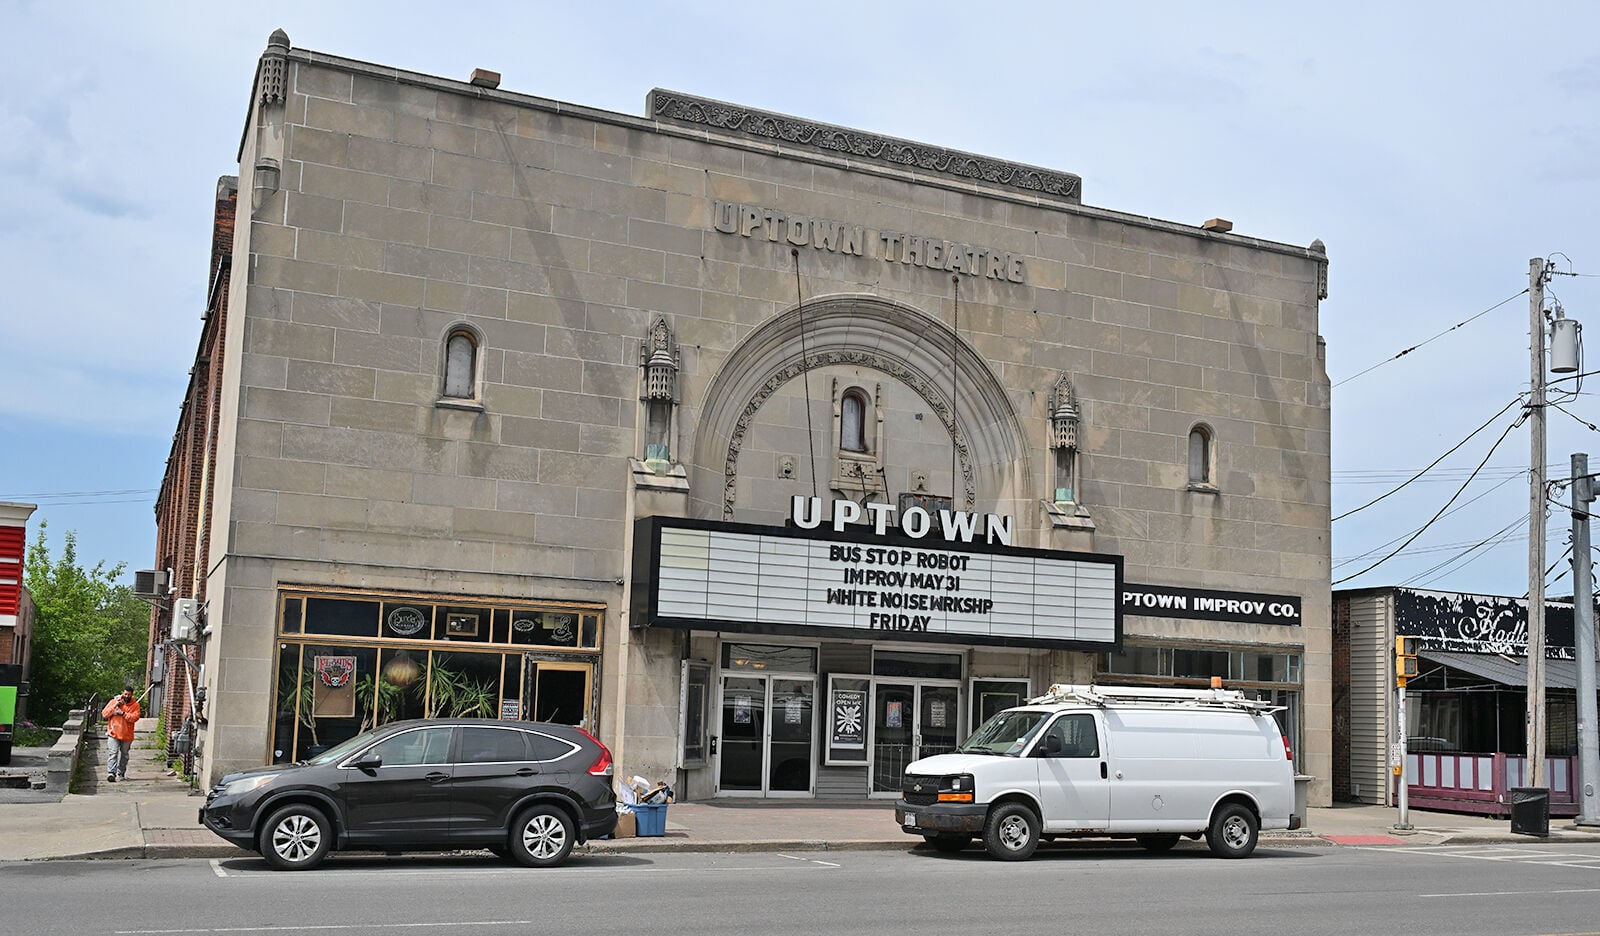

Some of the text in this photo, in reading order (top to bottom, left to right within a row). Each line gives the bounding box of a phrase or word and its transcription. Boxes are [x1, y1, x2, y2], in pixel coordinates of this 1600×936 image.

[713, 201, 1025, 284] UPTOWN THEATRE
[792, 495, 1014, 546] UPTOWN
[829, 545, 970, 571] BUS STOP ROBOT
[844, 567, 960, 591] IMPROV MAY 31
[827, 588, 993, 614] WHITE NOISE WRKSHP
[1122, 591, 1299, 618] PTOWN IMPROV CO.
[870, 612, 931, 632] FRIDAY
